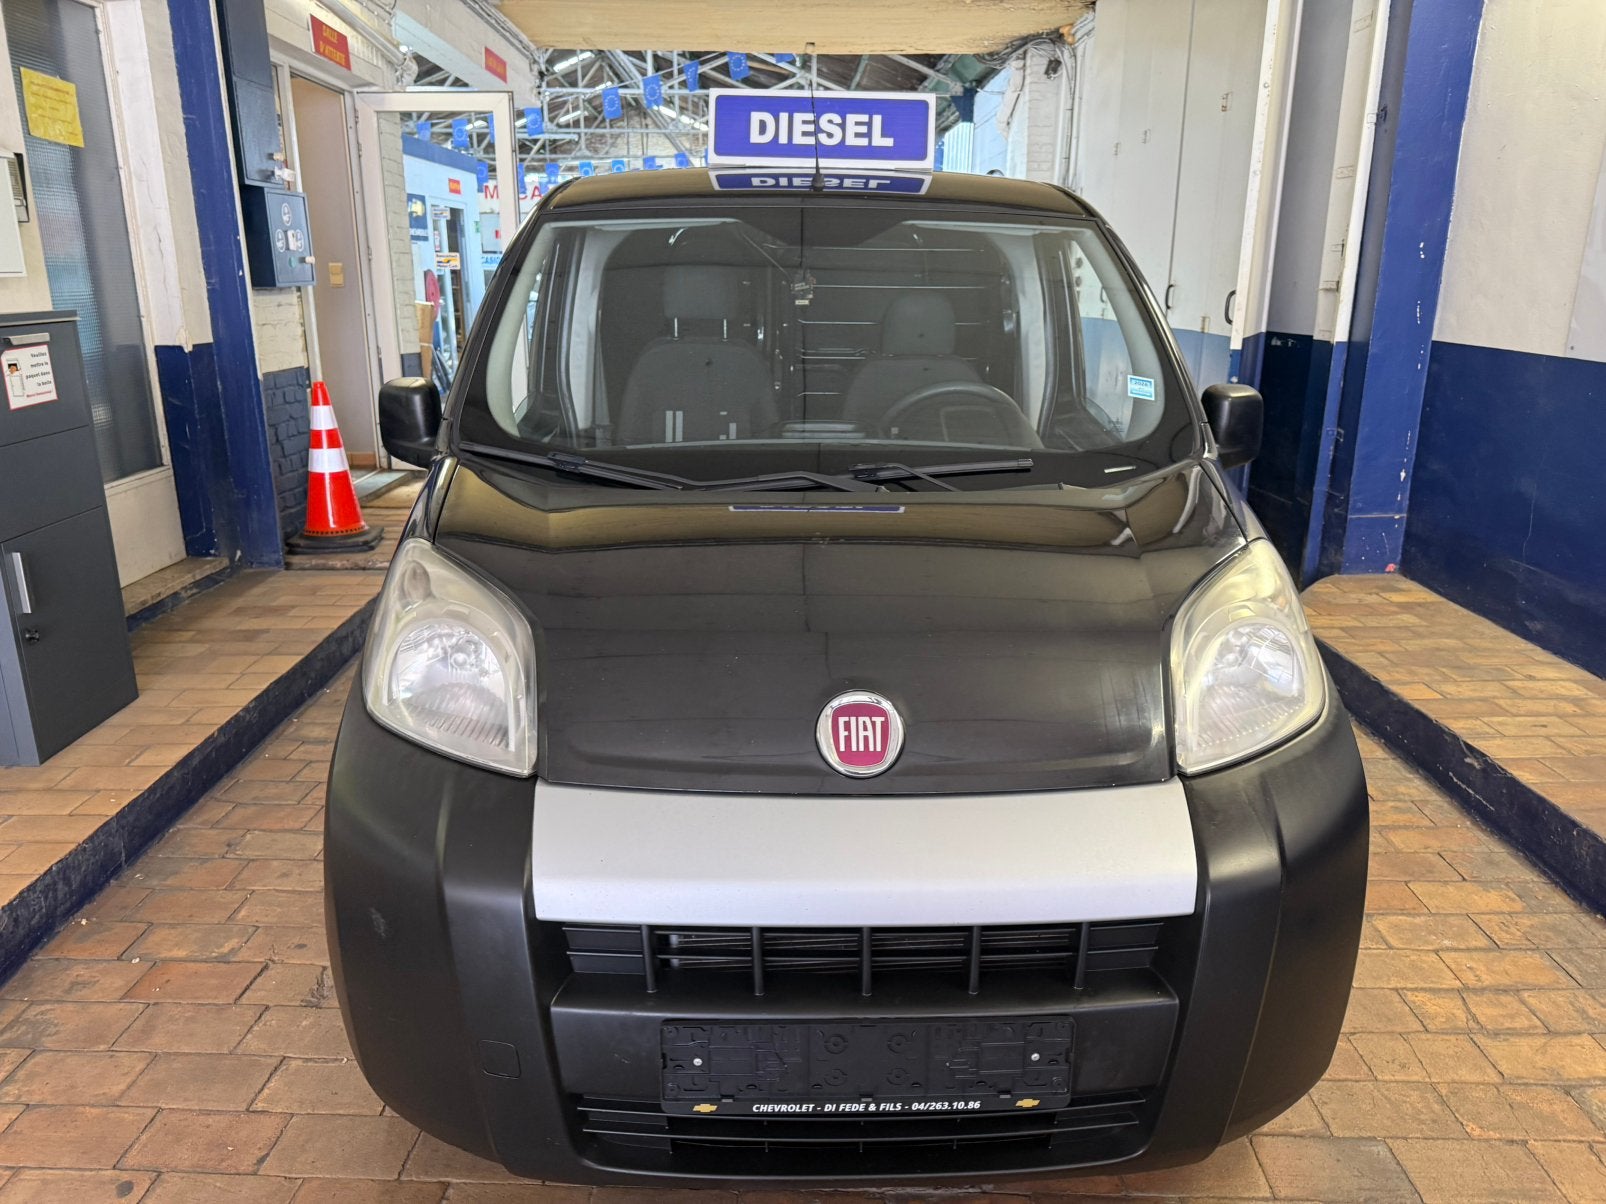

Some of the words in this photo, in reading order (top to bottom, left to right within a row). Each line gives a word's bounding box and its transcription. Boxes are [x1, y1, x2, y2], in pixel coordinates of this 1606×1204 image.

[749, 111, 894, 148] DIESEL
[838, 716, 885, 752] FIAT
[752, 1103, 815, 1113] CHEVROLET
[824, 1103, 836, 1112] DI
[838, 1103, 866, 1112] FEDE
[868, 1103, 877, 1112] &
[879, 1103, 902, 1111] FILS
[911, 1101, 981, 1111] 04/263.10.86
